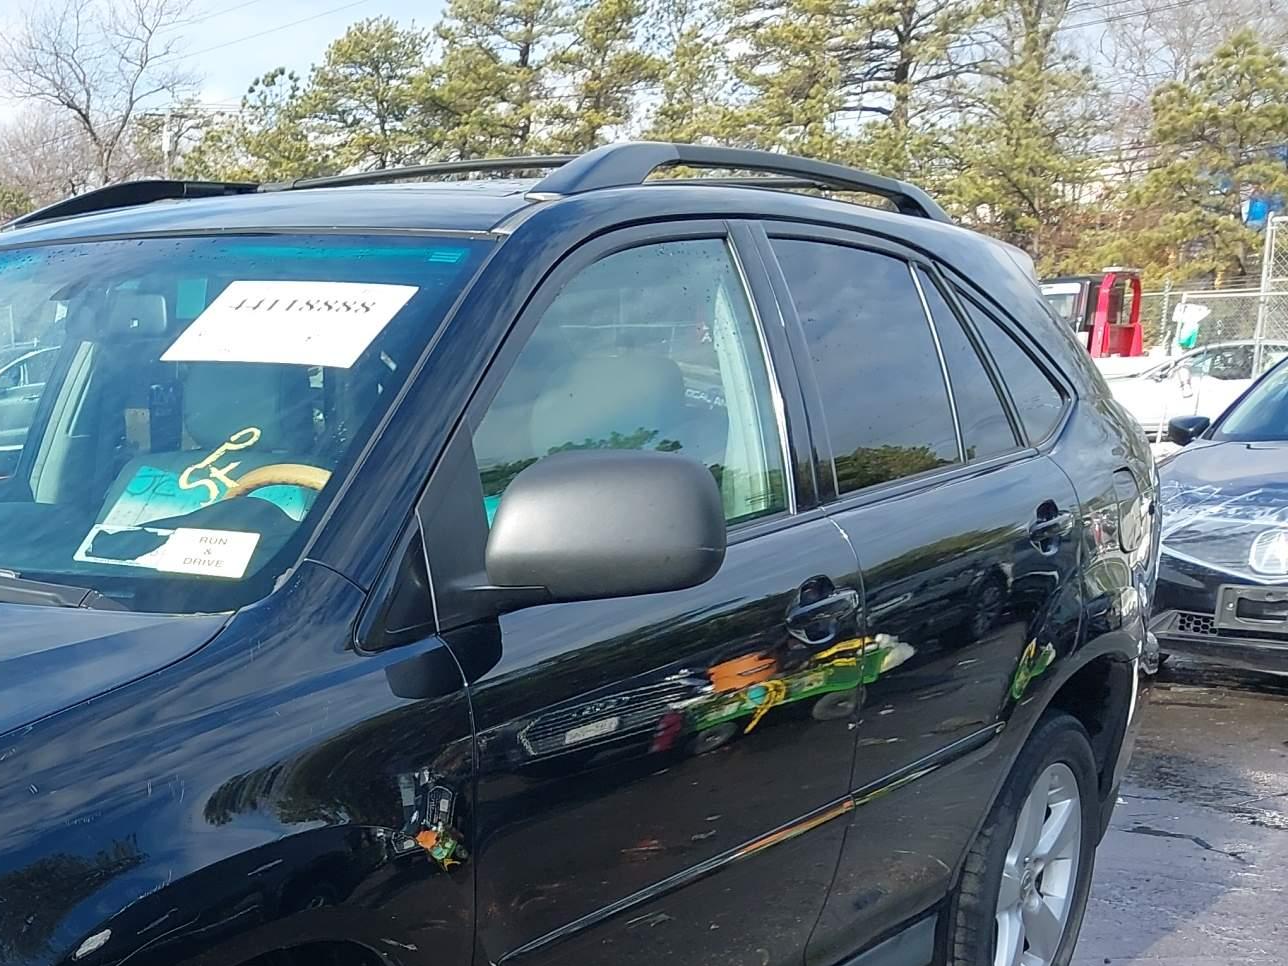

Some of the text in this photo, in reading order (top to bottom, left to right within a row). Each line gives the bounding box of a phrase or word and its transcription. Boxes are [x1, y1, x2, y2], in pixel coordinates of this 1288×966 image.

[229, 298, 376, 314] 44118888
[198, 536, 228, 545] RUN
[182, 557, 225, 568] DRIVE
